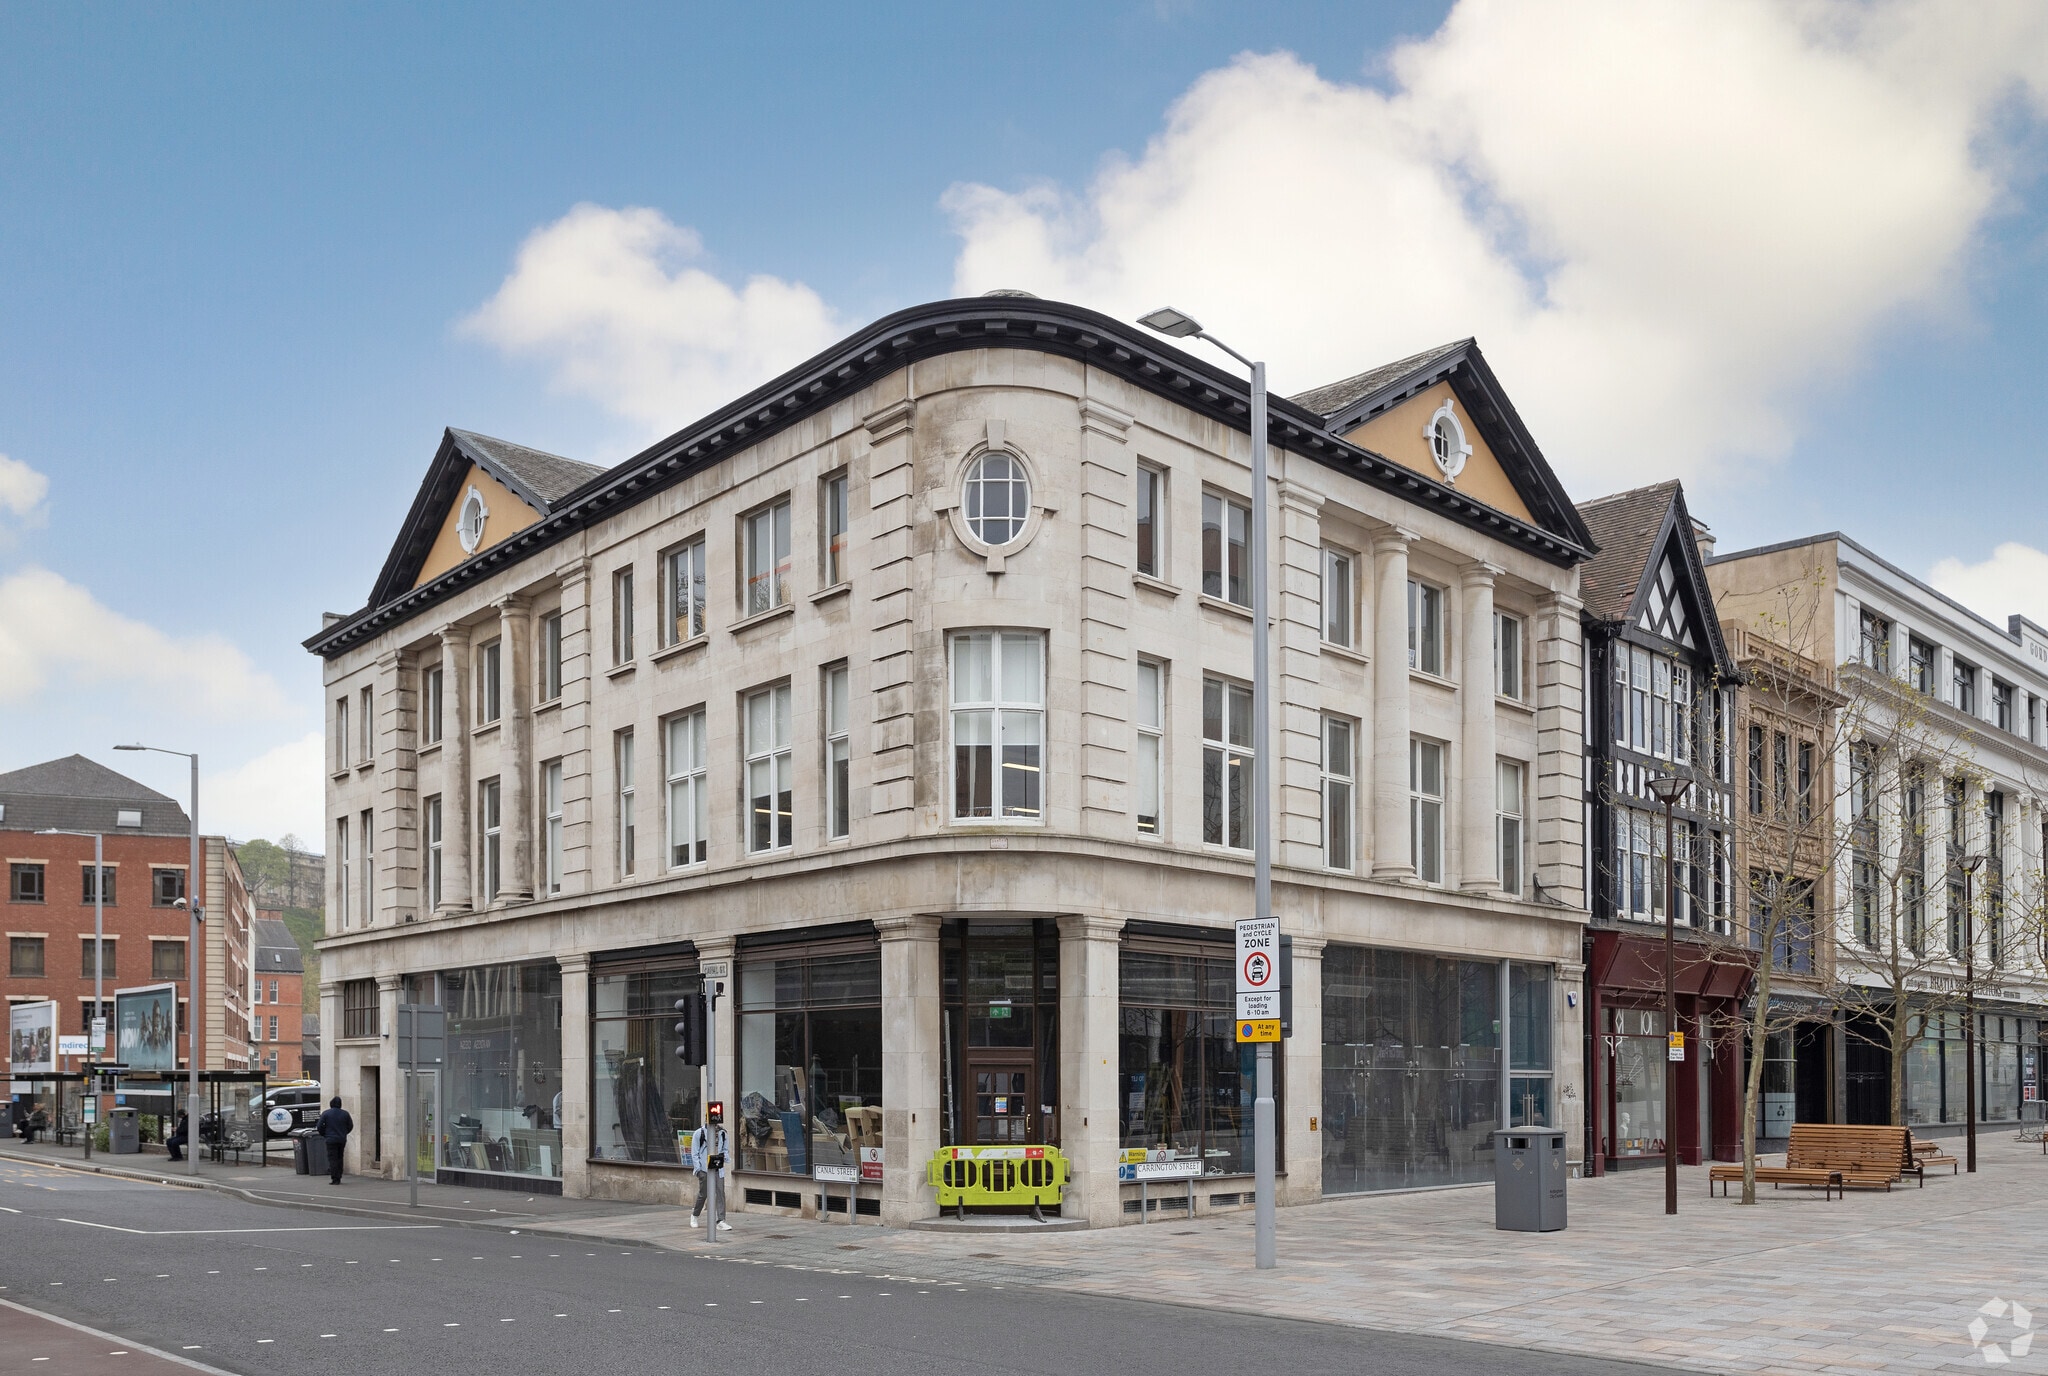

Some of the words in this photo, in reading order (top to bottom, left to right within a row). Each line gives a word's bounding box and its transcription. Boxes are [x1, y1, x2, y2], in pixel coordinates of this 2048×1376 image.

[1240, 923, 1275, 931] PEDESTRIAN
[1244, 938, 1270, 948] ZONE
[817, 1166, 835, 1175] CANAL
[837, 1168, 856, 1176] STREET
[1137, 1162, 1177, 1173] CARRINGTON
[1180, 1161, 1200, 1170] STREET
